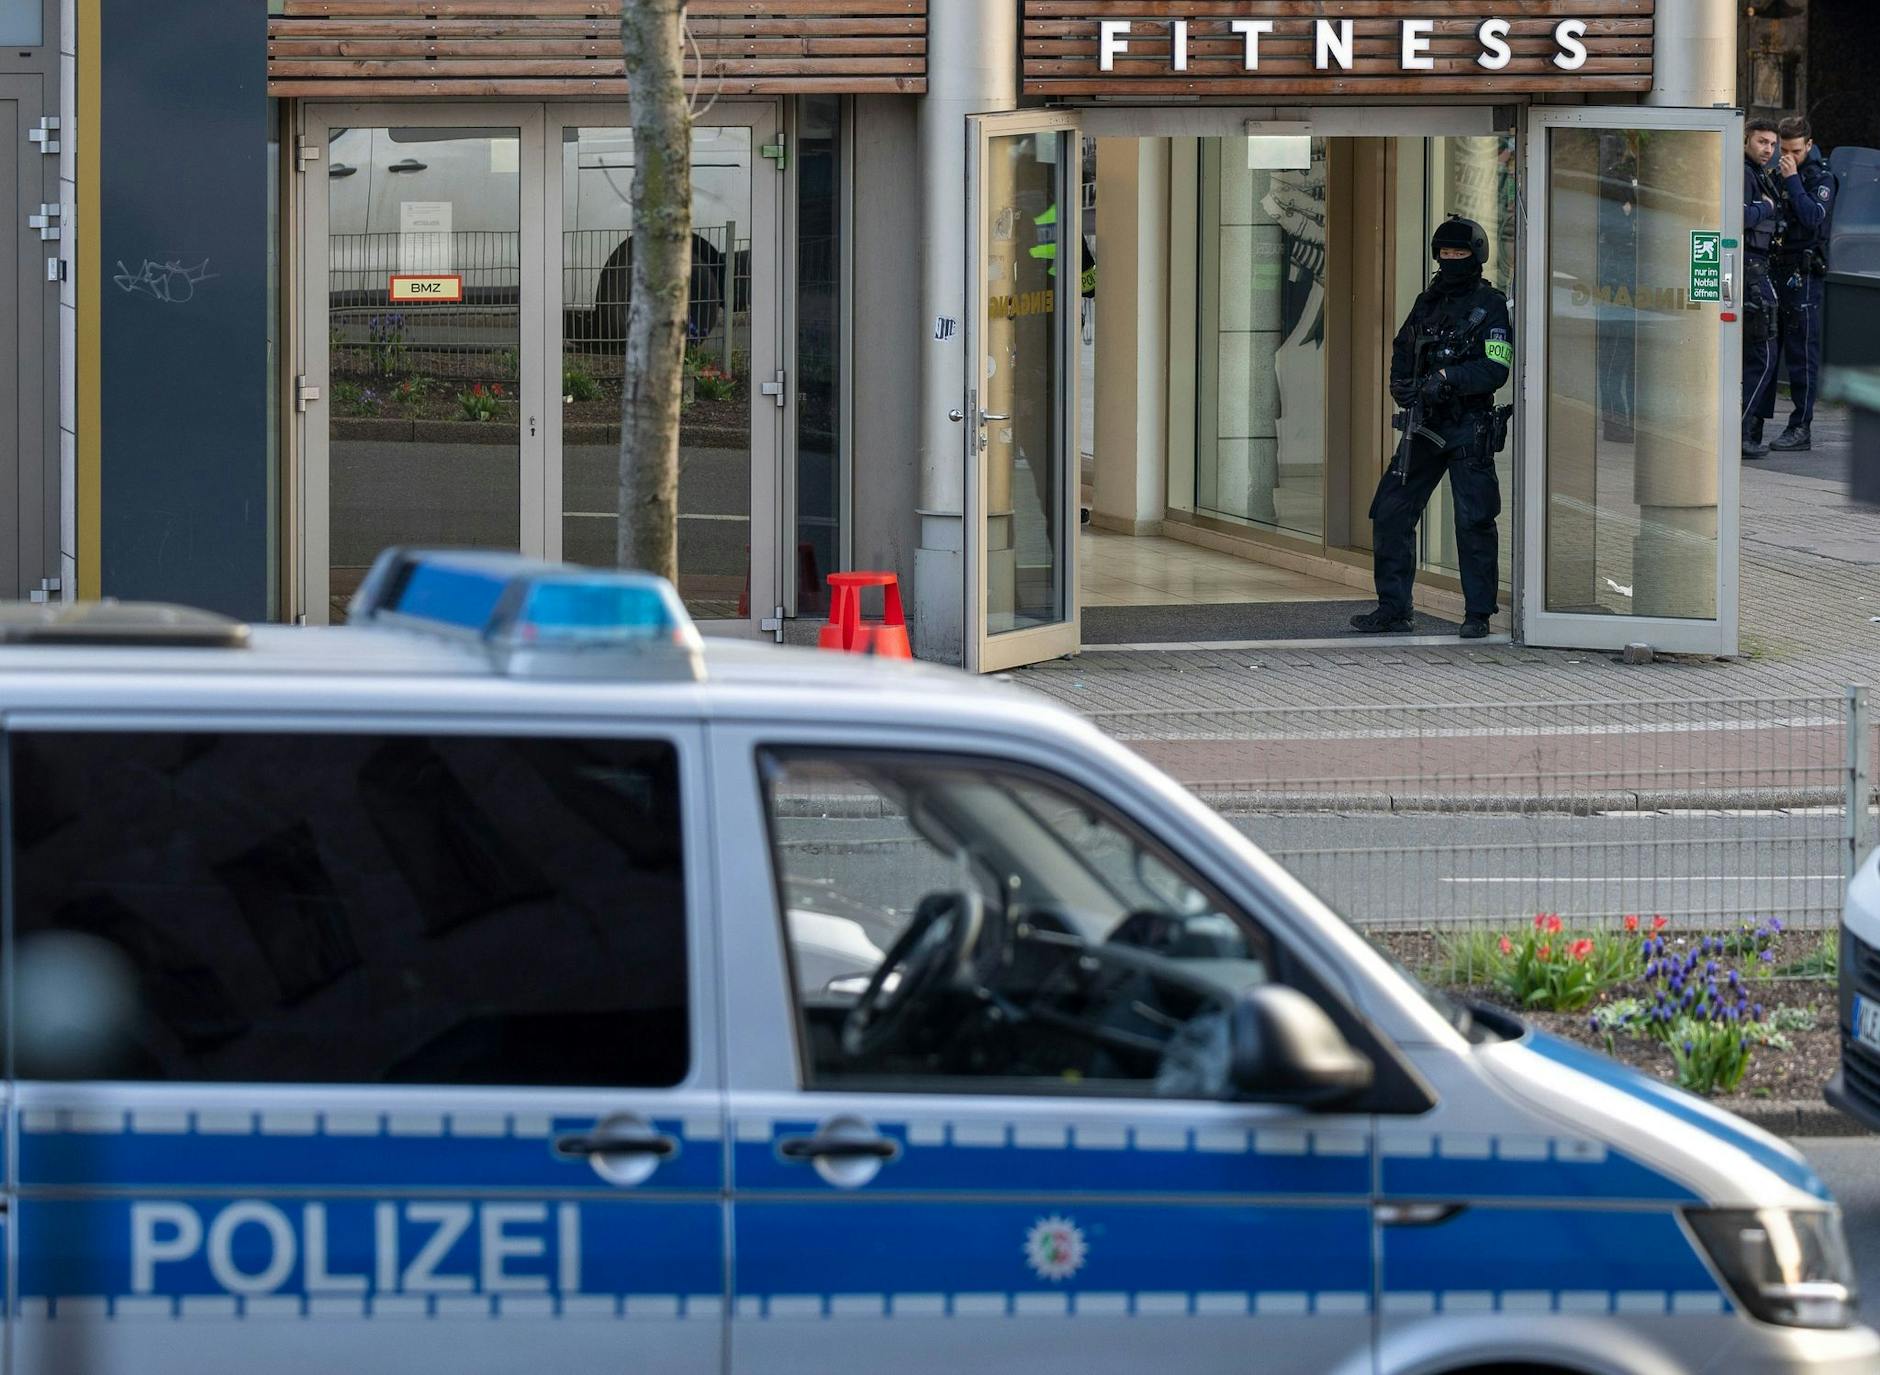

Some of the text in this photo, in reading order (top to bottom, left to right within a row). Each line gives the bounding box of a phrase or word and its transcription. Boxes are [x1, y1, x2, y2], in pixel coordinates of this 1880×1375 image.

[1100, 19, 1588, 70] FITNESS
[1694, 267, 1718, 276] nur im
[1694, 278, 1718, 287] Notfall
[410, 283, 441, 293] BMZ
[1694, 288, 1718, 297] öffnen
[130, 1201, 583, 1294] POLIZEI
